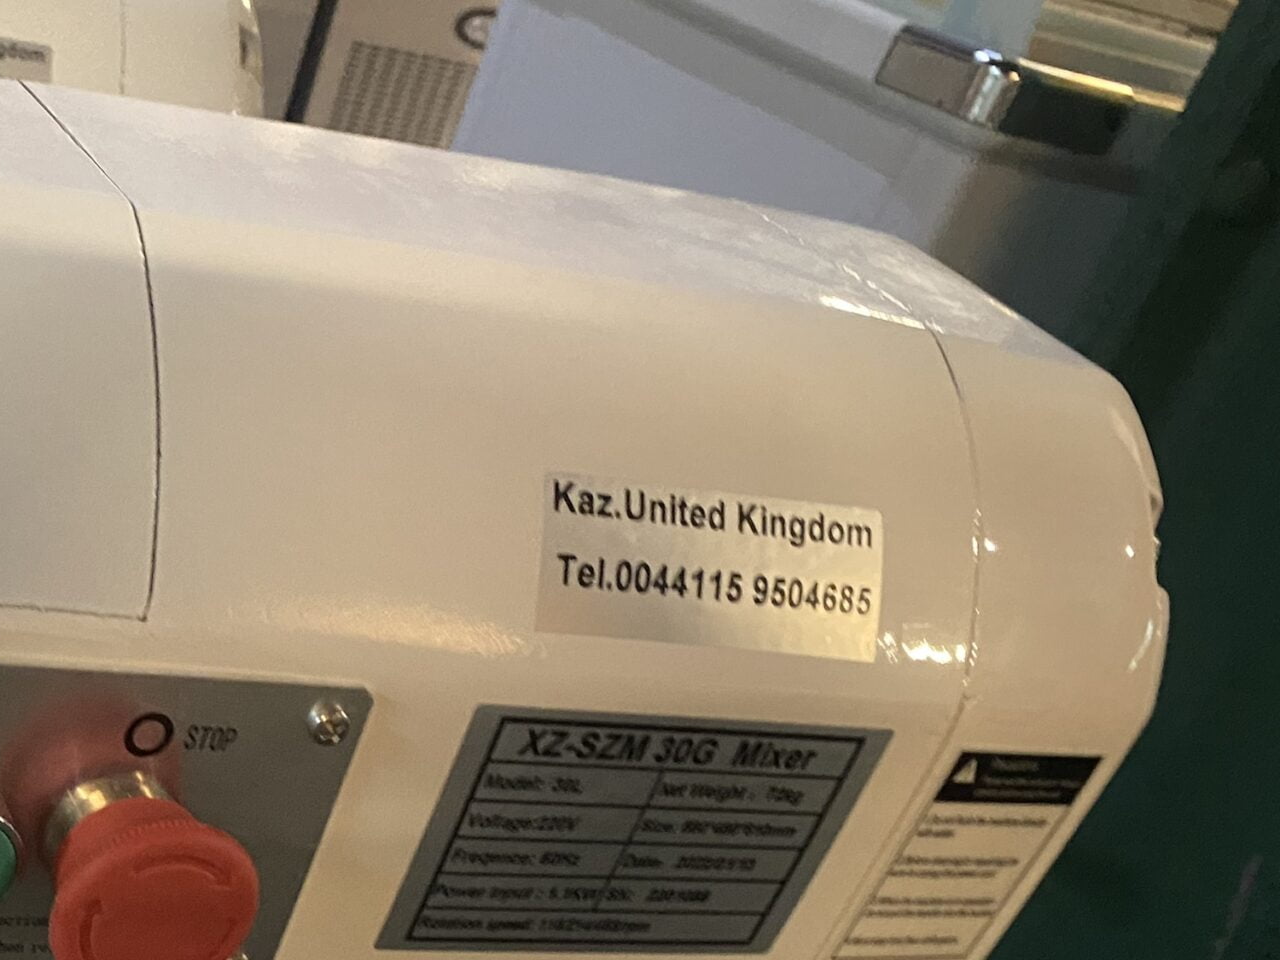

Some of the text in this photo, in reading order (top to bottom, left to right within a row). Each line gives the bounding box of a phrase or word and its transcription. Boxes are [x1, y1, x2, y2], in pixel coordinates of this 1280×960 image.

[553, 479, 874, 548] Kaz.United Kingdom
[558, 553, 872, 615] Tel.0044115 9504685
[183, 725, 238, 751] STOP
[519, 728, 817, 770] XZ-SZM 30G Mixer
